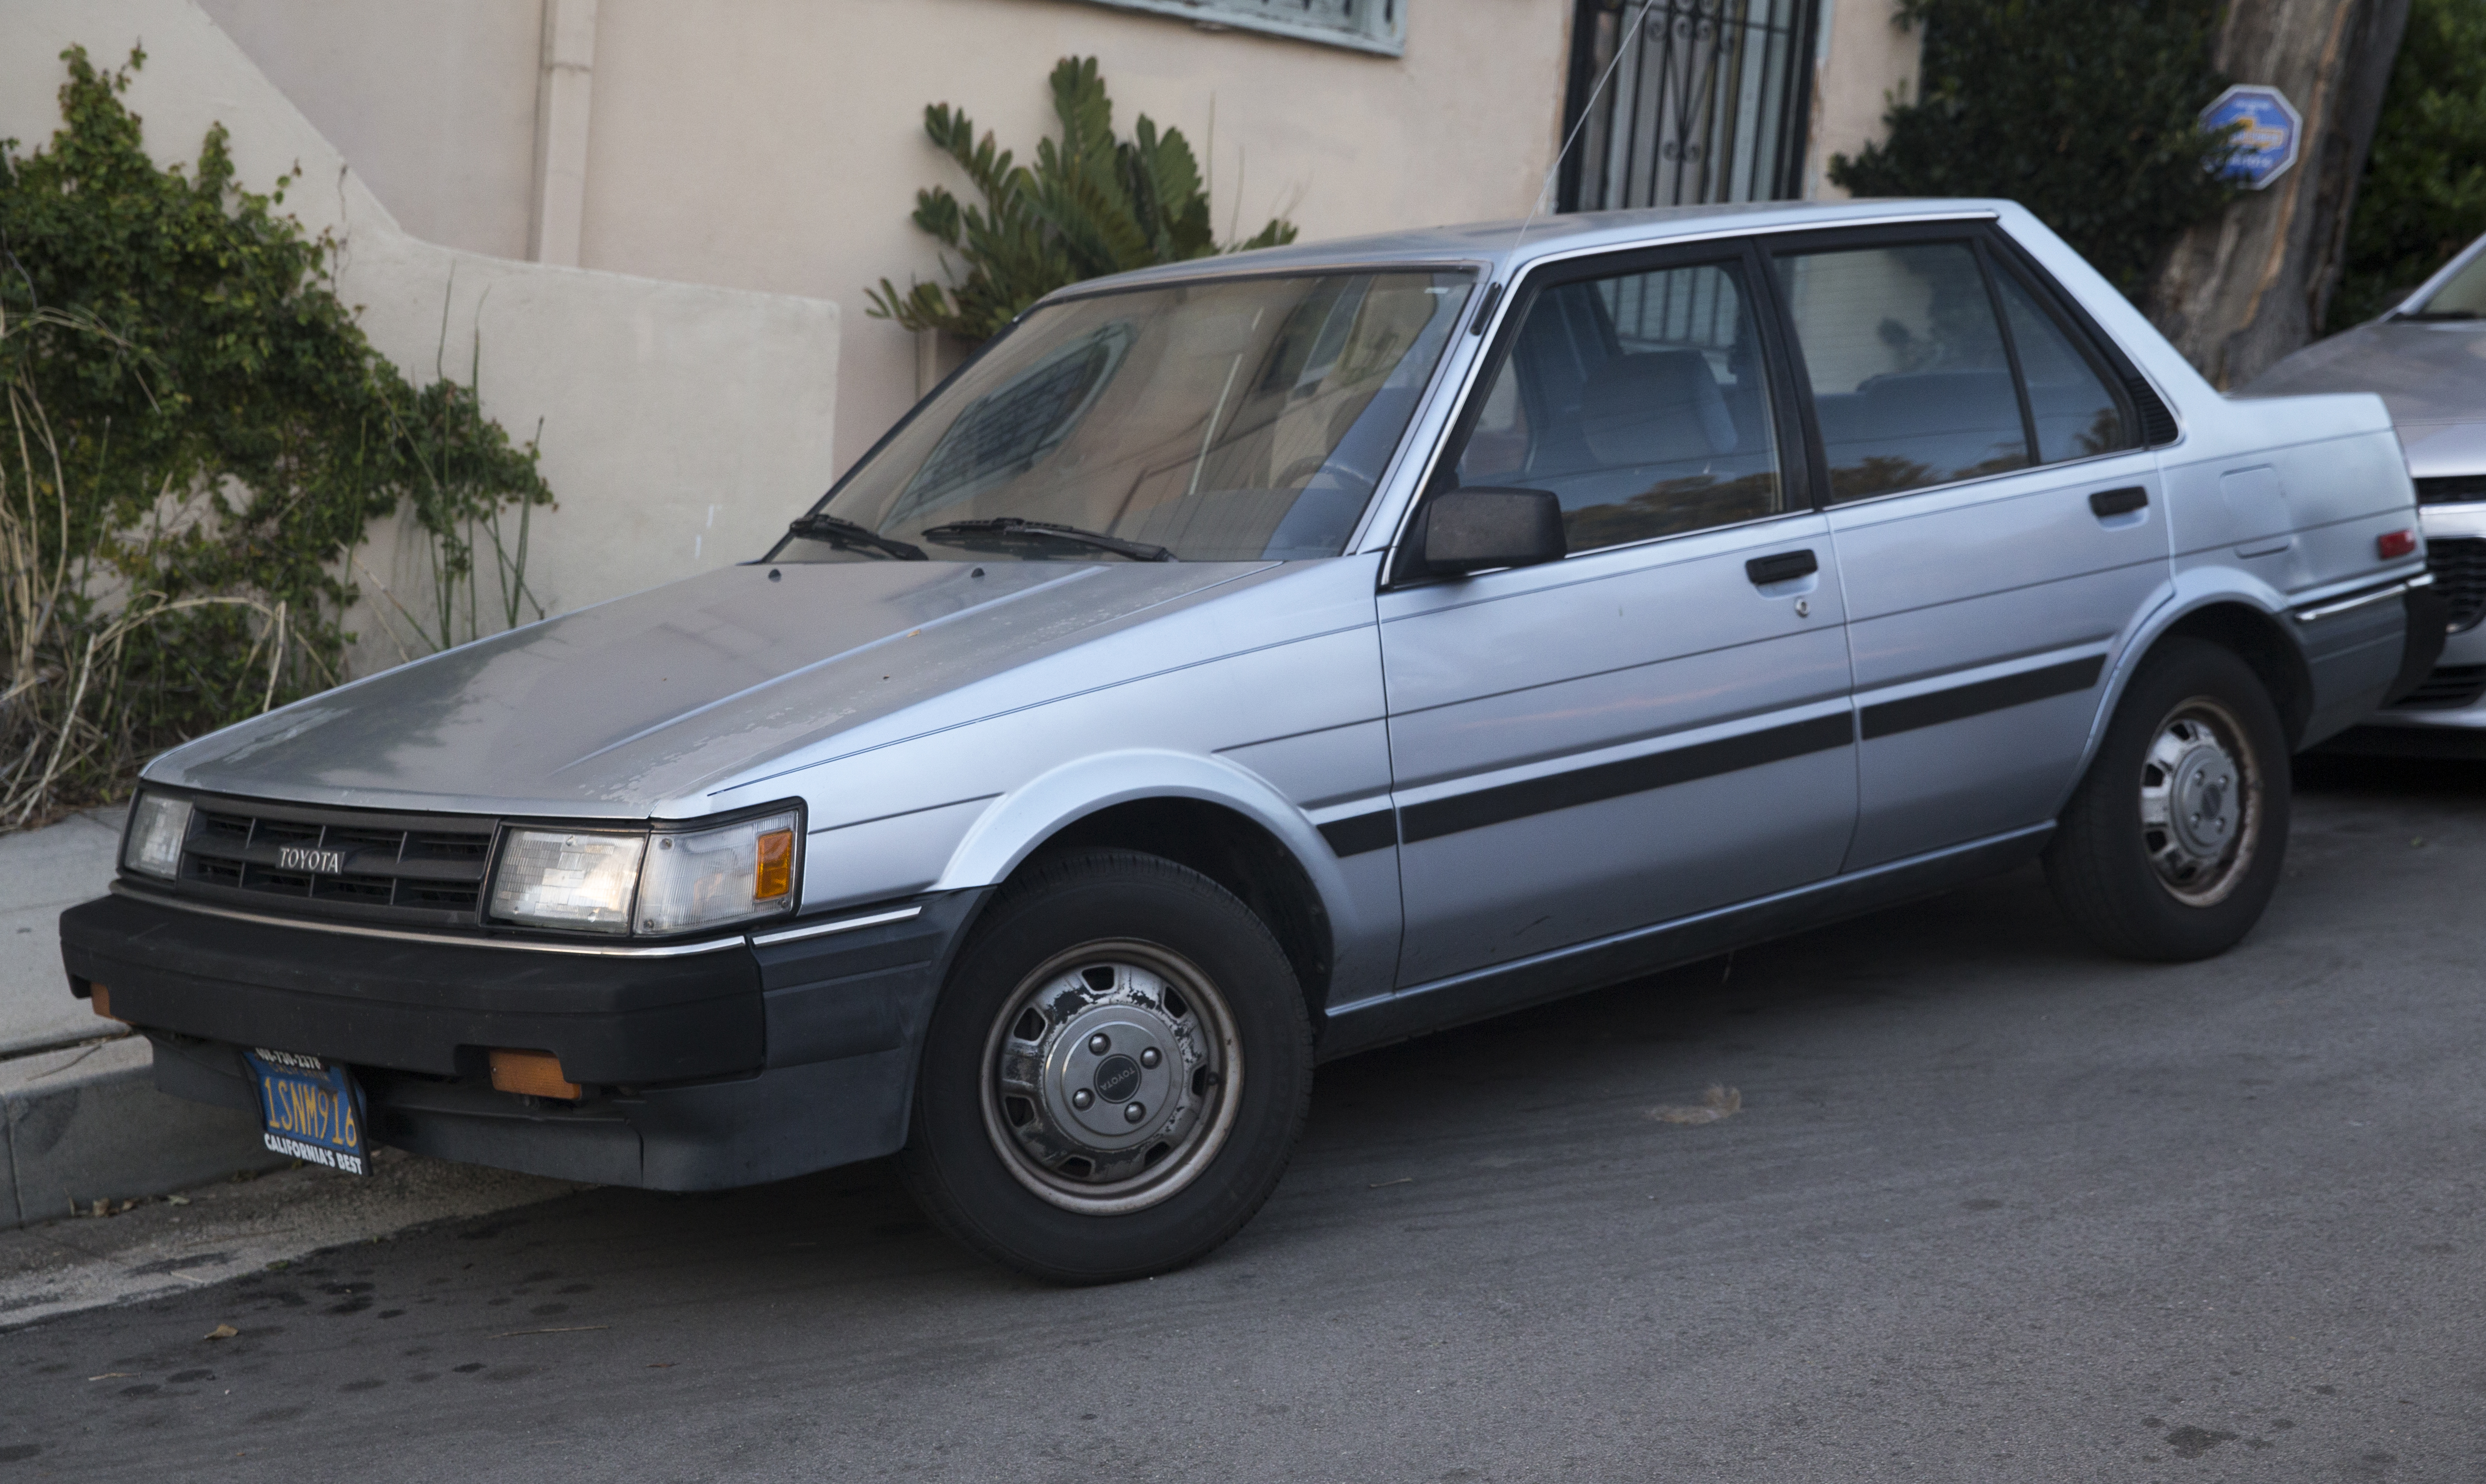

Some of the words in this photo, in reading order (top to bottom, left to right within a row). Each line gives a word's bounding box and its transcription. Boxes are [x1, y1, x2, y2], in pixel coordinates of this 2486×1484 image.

[280, 847, 339, 874] TOYOTA
[1100, 1067, 1136, 1091] TOYOTA
[264, 1077, 357, 1148] 1SNM916
[264, 1133, 335, 1168] CALIFORNIA'S
[335, 1152, 363, 1175] BEST
